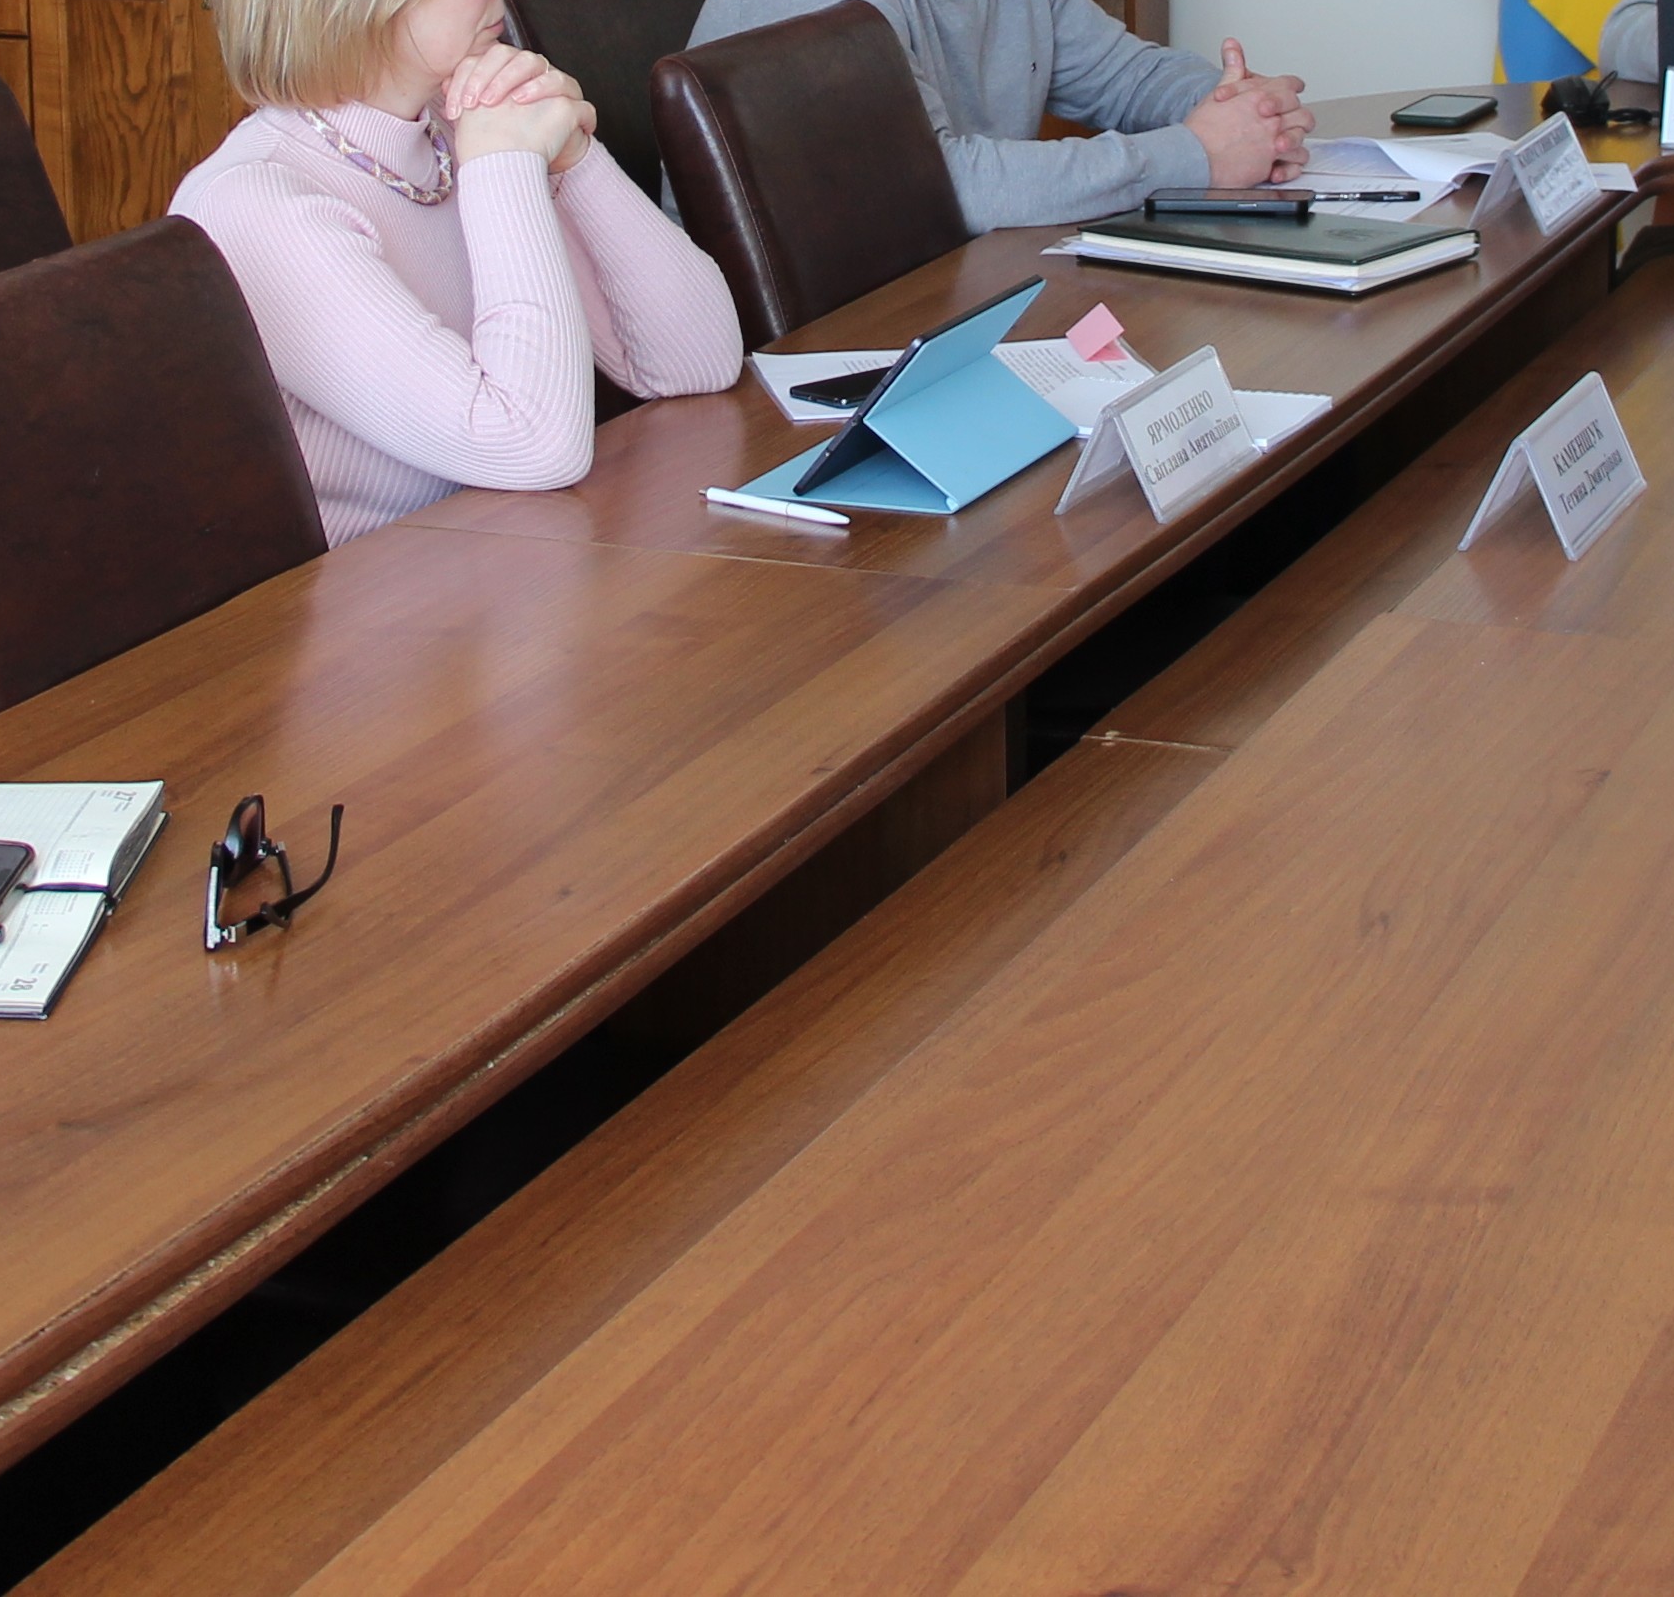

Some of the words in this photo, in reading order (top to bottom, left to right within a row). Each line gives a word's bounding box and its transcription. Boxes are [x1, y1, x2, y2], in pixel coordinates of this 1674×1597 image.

[1147, 390, 1214, 446] ЯРМОЛЕНКО
[1145, 449, 1190, 485] Світлана
[1188, 413, 1241, 458] Анатоліївна
[1552, 419, 1604, 477] КАМЕНЩУК
[1558, 479, 1589, 514] Тетяна
[10, 978, 38, 991] 28
